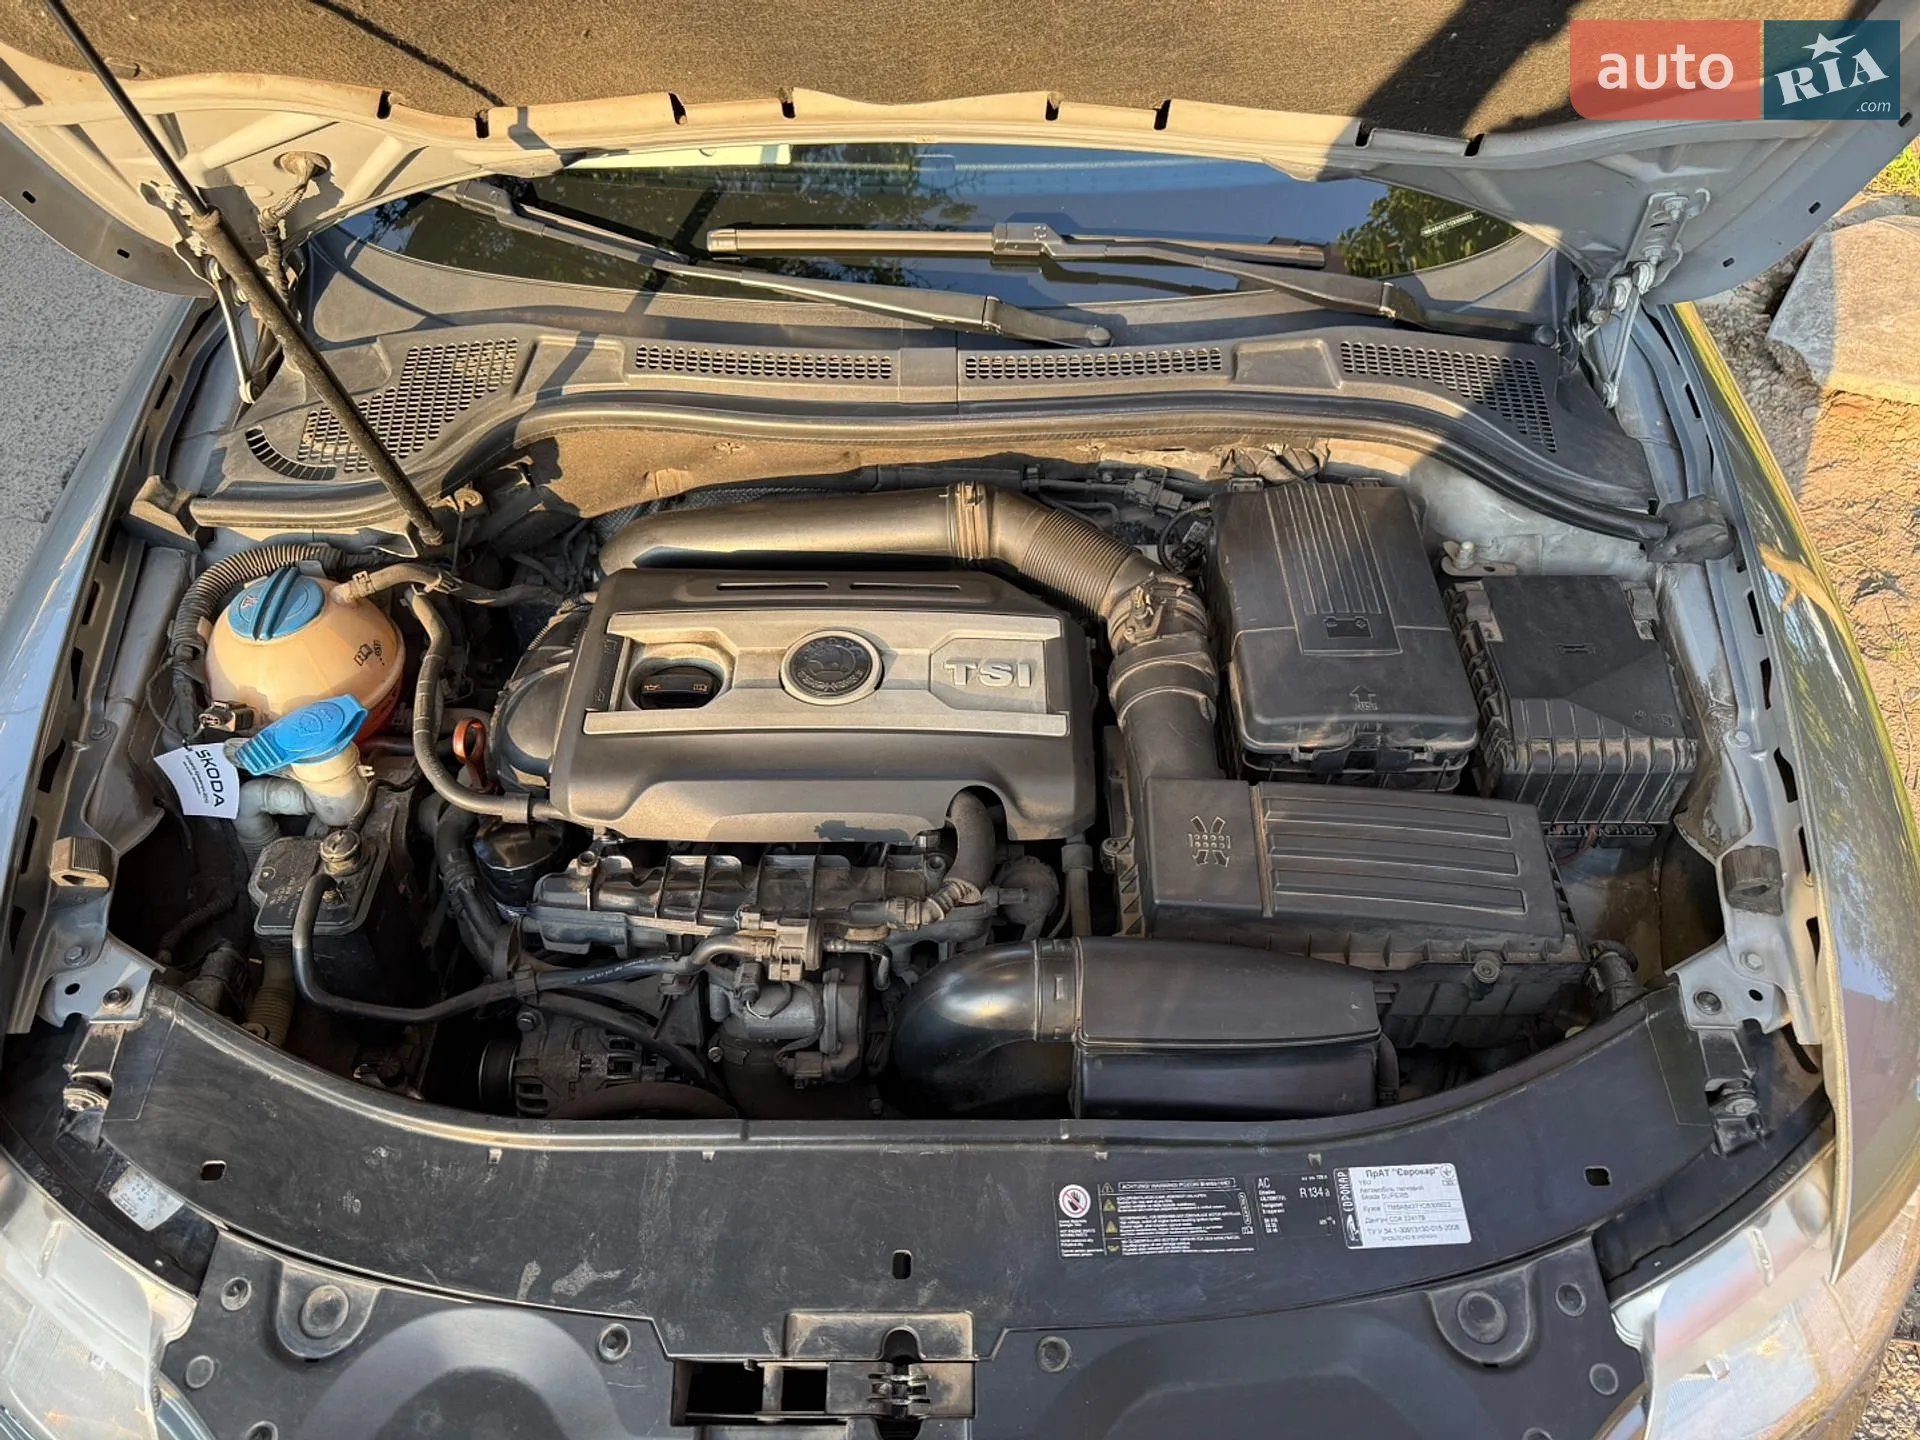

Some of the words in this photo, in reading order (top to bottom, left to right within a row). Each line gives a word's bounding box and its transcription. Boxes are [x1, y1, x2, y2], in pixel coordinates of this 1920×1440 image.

[943, 660, 1031, 688] TSI
[1365, 1168, 1390, 1180] ПрАТ
[1257, 1177, 1270, 1189] AC
